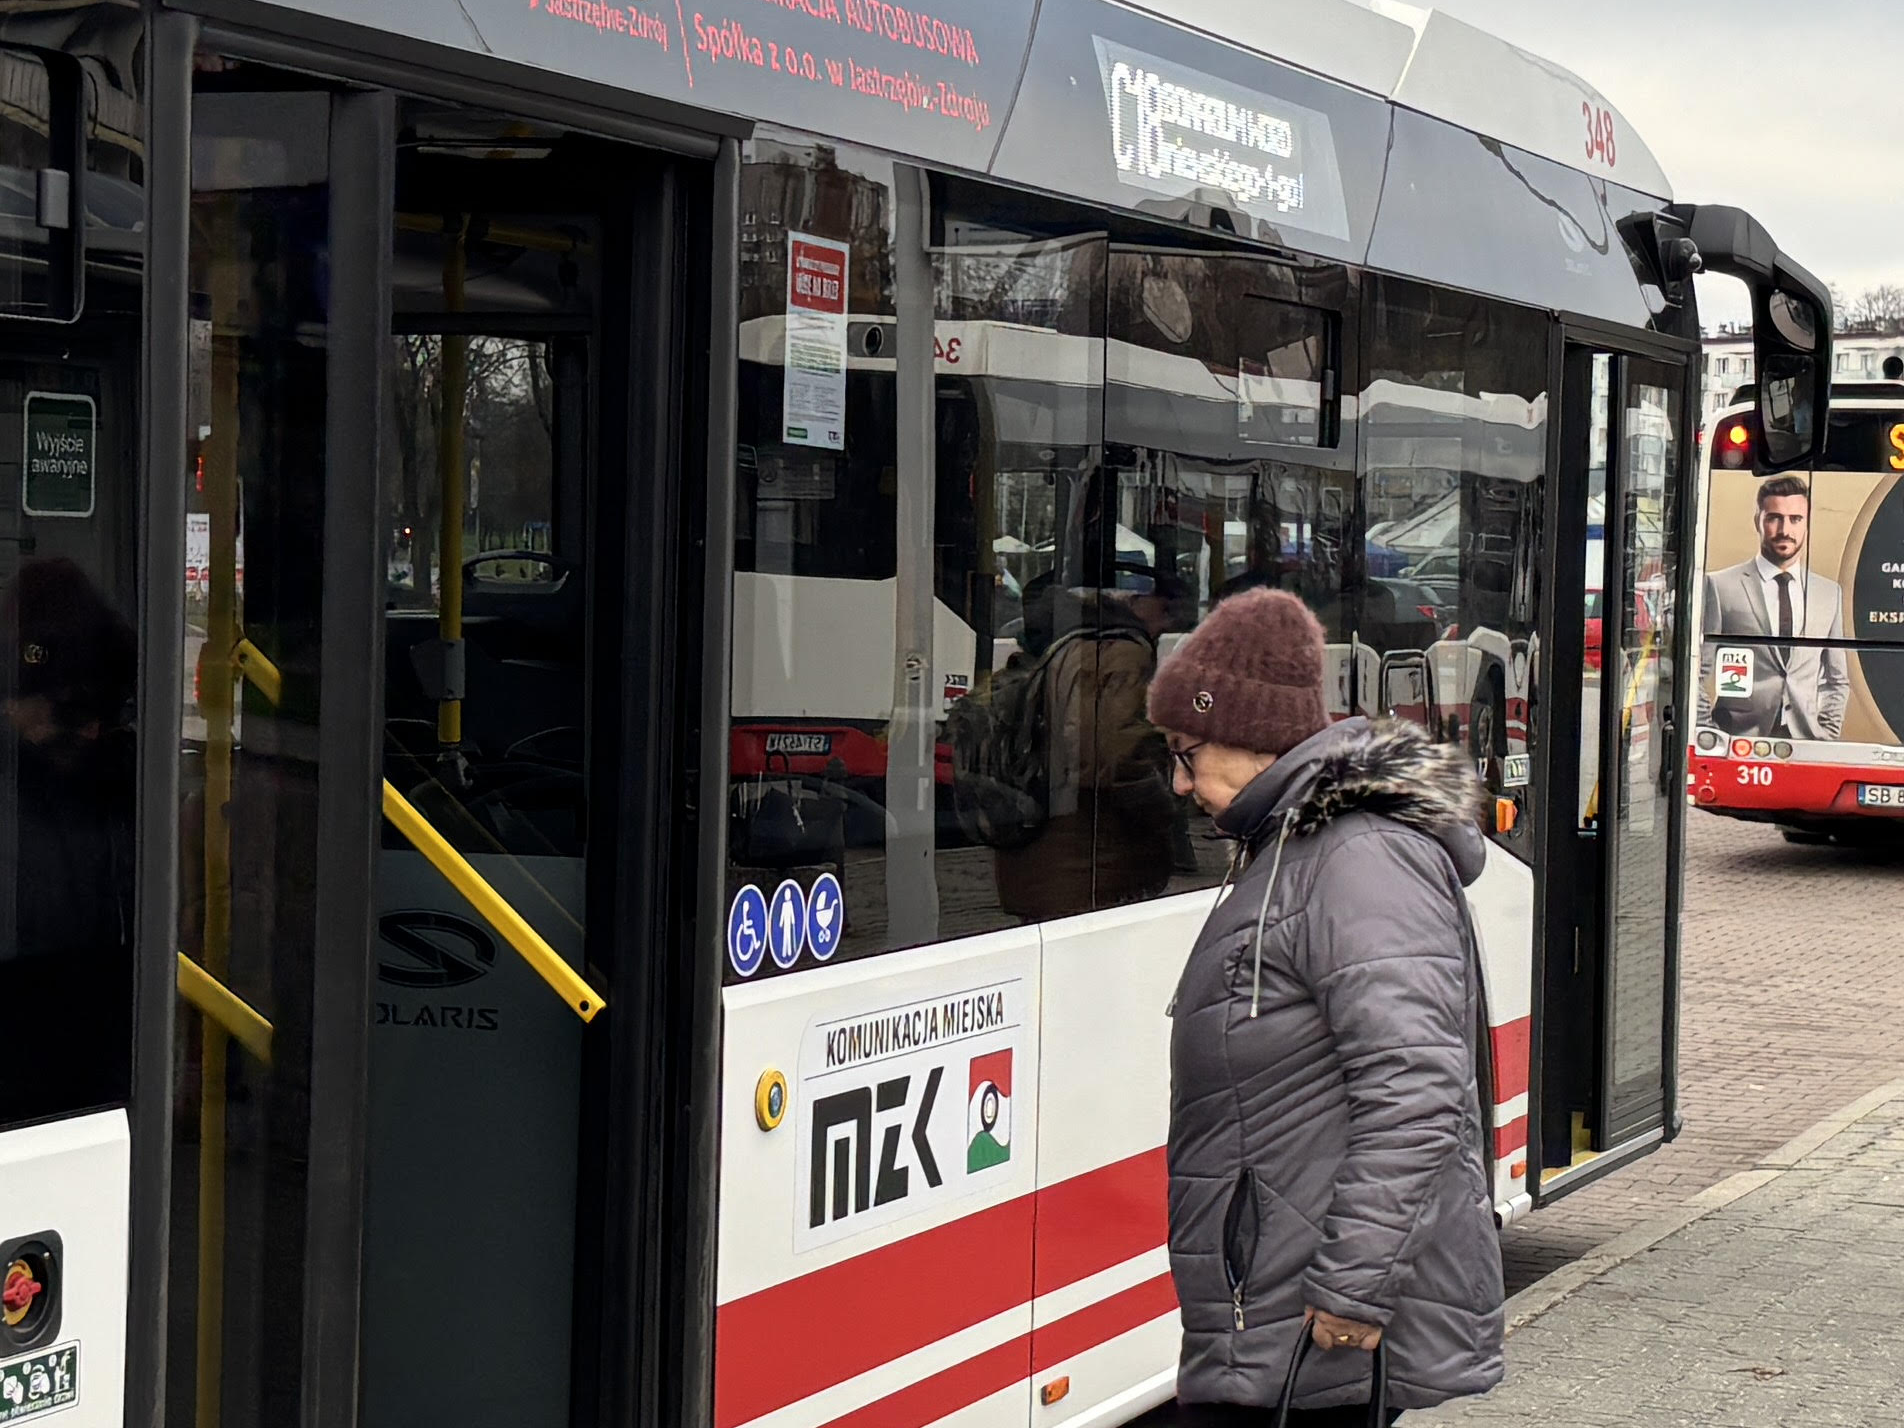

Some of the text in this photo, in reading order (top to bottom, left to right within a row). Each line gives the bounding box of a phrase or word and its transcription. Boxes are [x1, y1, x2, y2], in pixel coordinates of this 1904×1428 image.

[694, 12, 764, 65] Spółka
[768, 43, 781, 71] z
[785, 47, 823, 82] o.o.
[825, 59, 843, 86] w
[1581, 101, 1617, 168] 348
[31, 458, 88, 479] awaryjne
[1736, 765, 1773, 786] 310
[1868, 787, 1892, 803] SB
[826, 990, 1005, 1068] KOMUNIKACJA MIEJSKA
[809, 1065, 945, 1230] MZK
